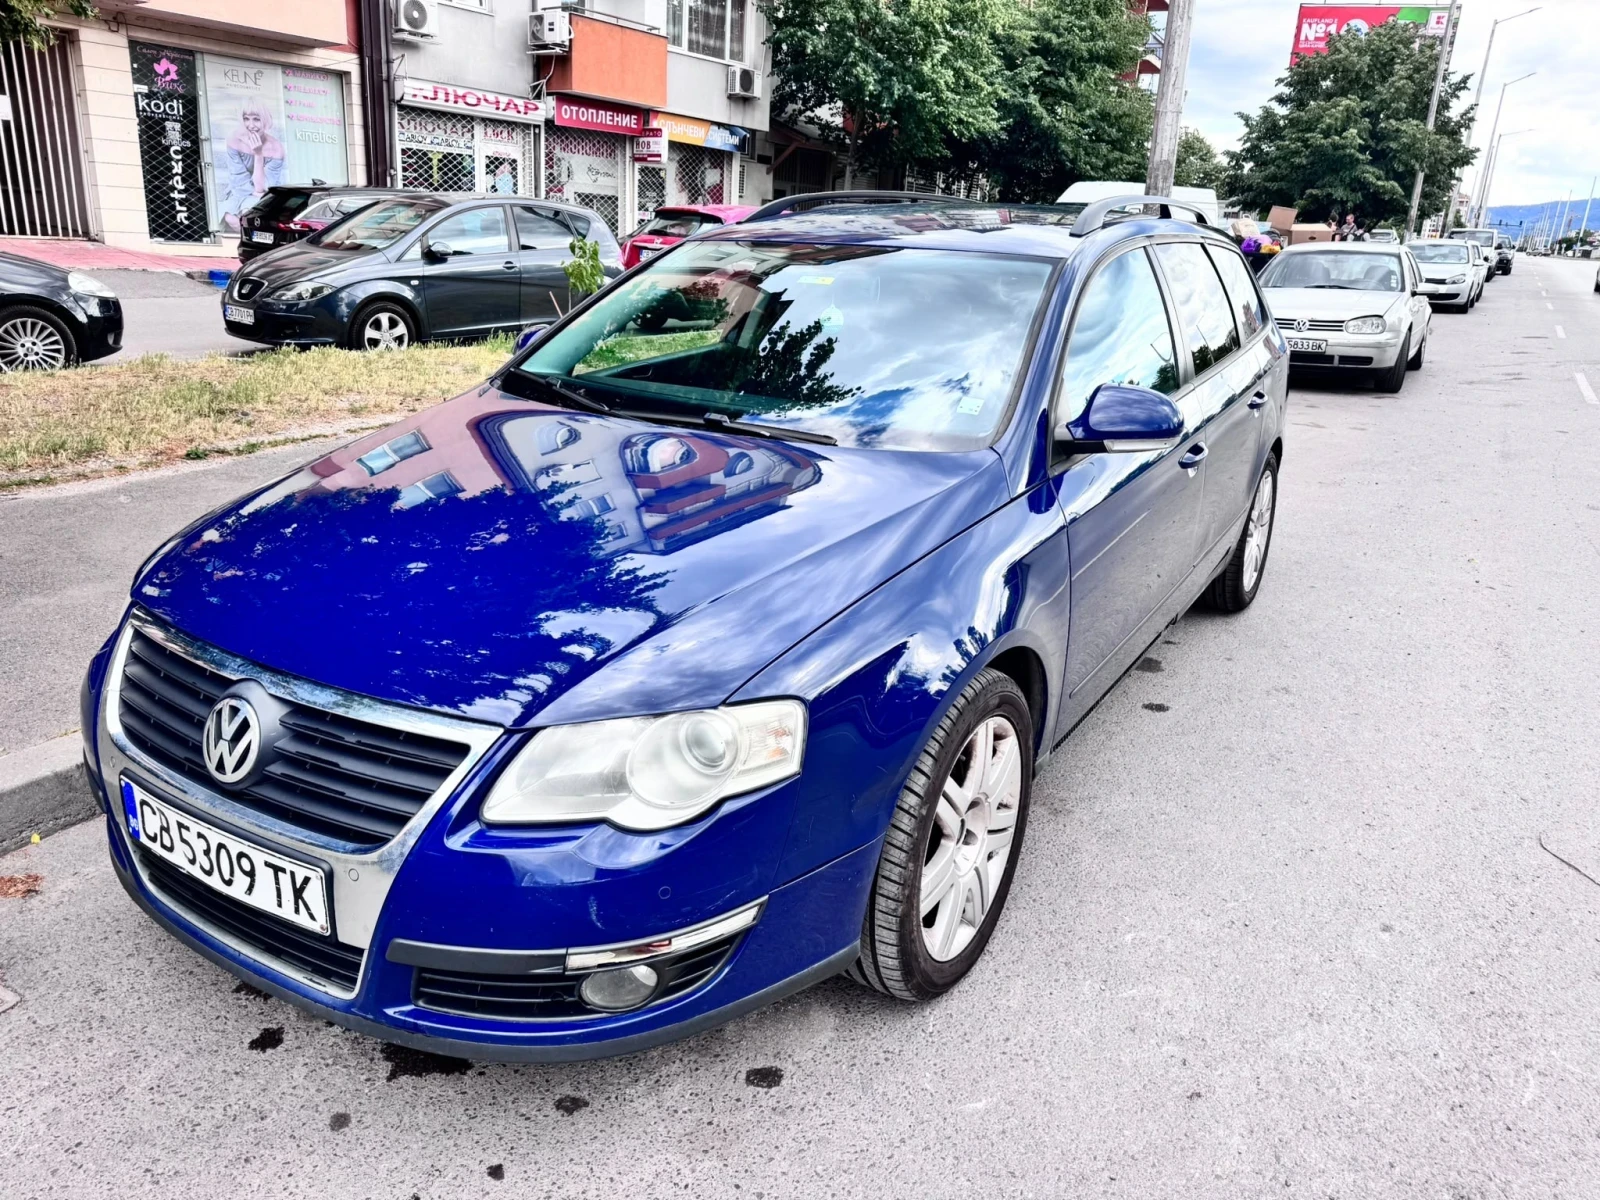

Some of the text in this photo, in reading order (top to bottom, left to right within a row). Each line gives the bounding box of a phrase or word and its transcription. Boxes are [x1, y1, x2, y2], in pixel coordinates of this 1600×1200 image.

[223, 69, 261, 87] KEUNE
[138, 94, 183, 116] kodi
[561, 105, 638, 129] ОТОПЛЕНИЕ
[161, 136, 191, 148] kinetics
[296, 128, 339, 144] kinetics
[660, 119, 739, 146] СЛЪНЧЕВИ СИСТЕМИ
[1287, 340, 1324, 351] 5833 BK
[264, 860, 317, 922] TK
